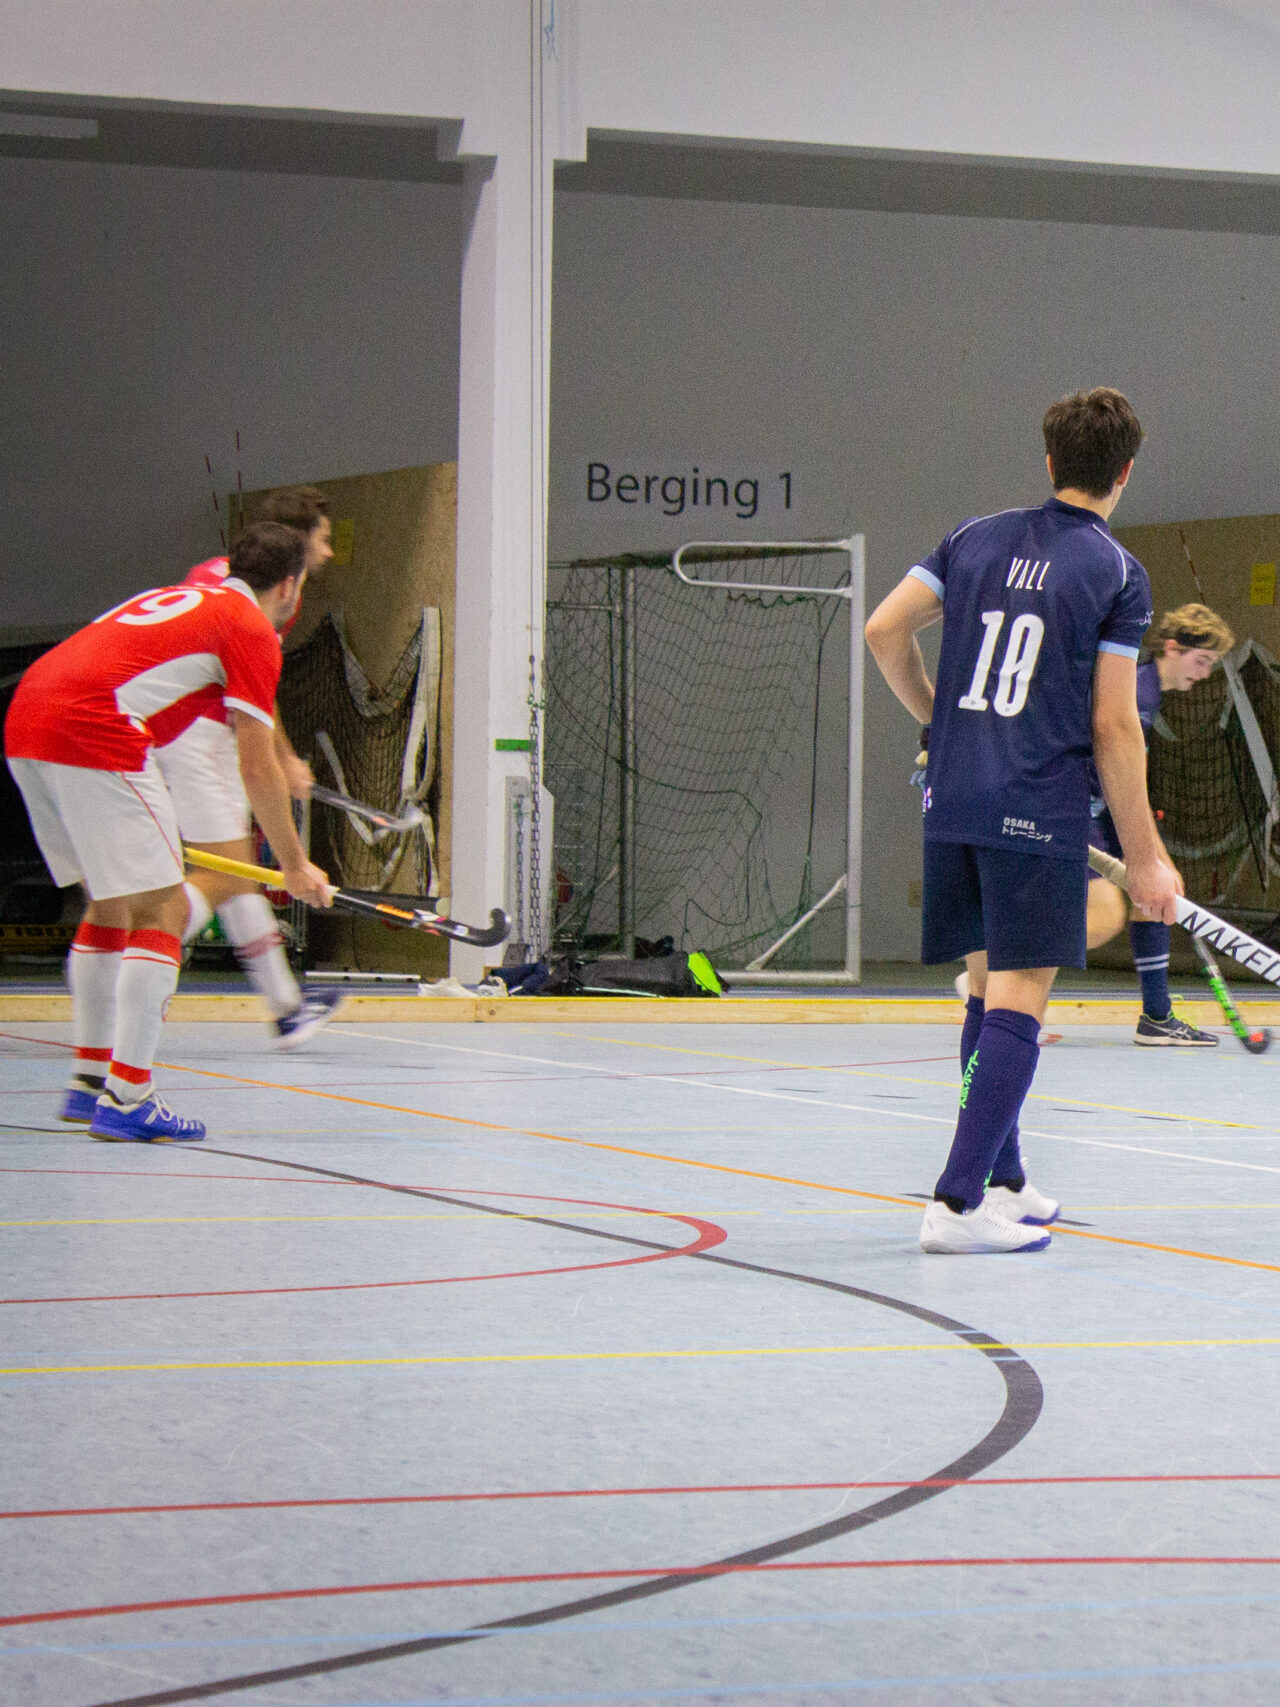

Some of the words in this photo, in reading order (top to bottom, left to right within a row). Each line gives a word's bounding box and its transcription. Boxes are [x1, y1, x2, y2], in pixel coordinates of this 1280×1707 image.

[586, 462, 759, 519] Berging
[779, 471, 792, 510] 1
[1006, 557, 1050, 590] VALL
[1002, 826, 1053, 843] トレーニング
[1003, 817, 1036, 831] OSAKA
